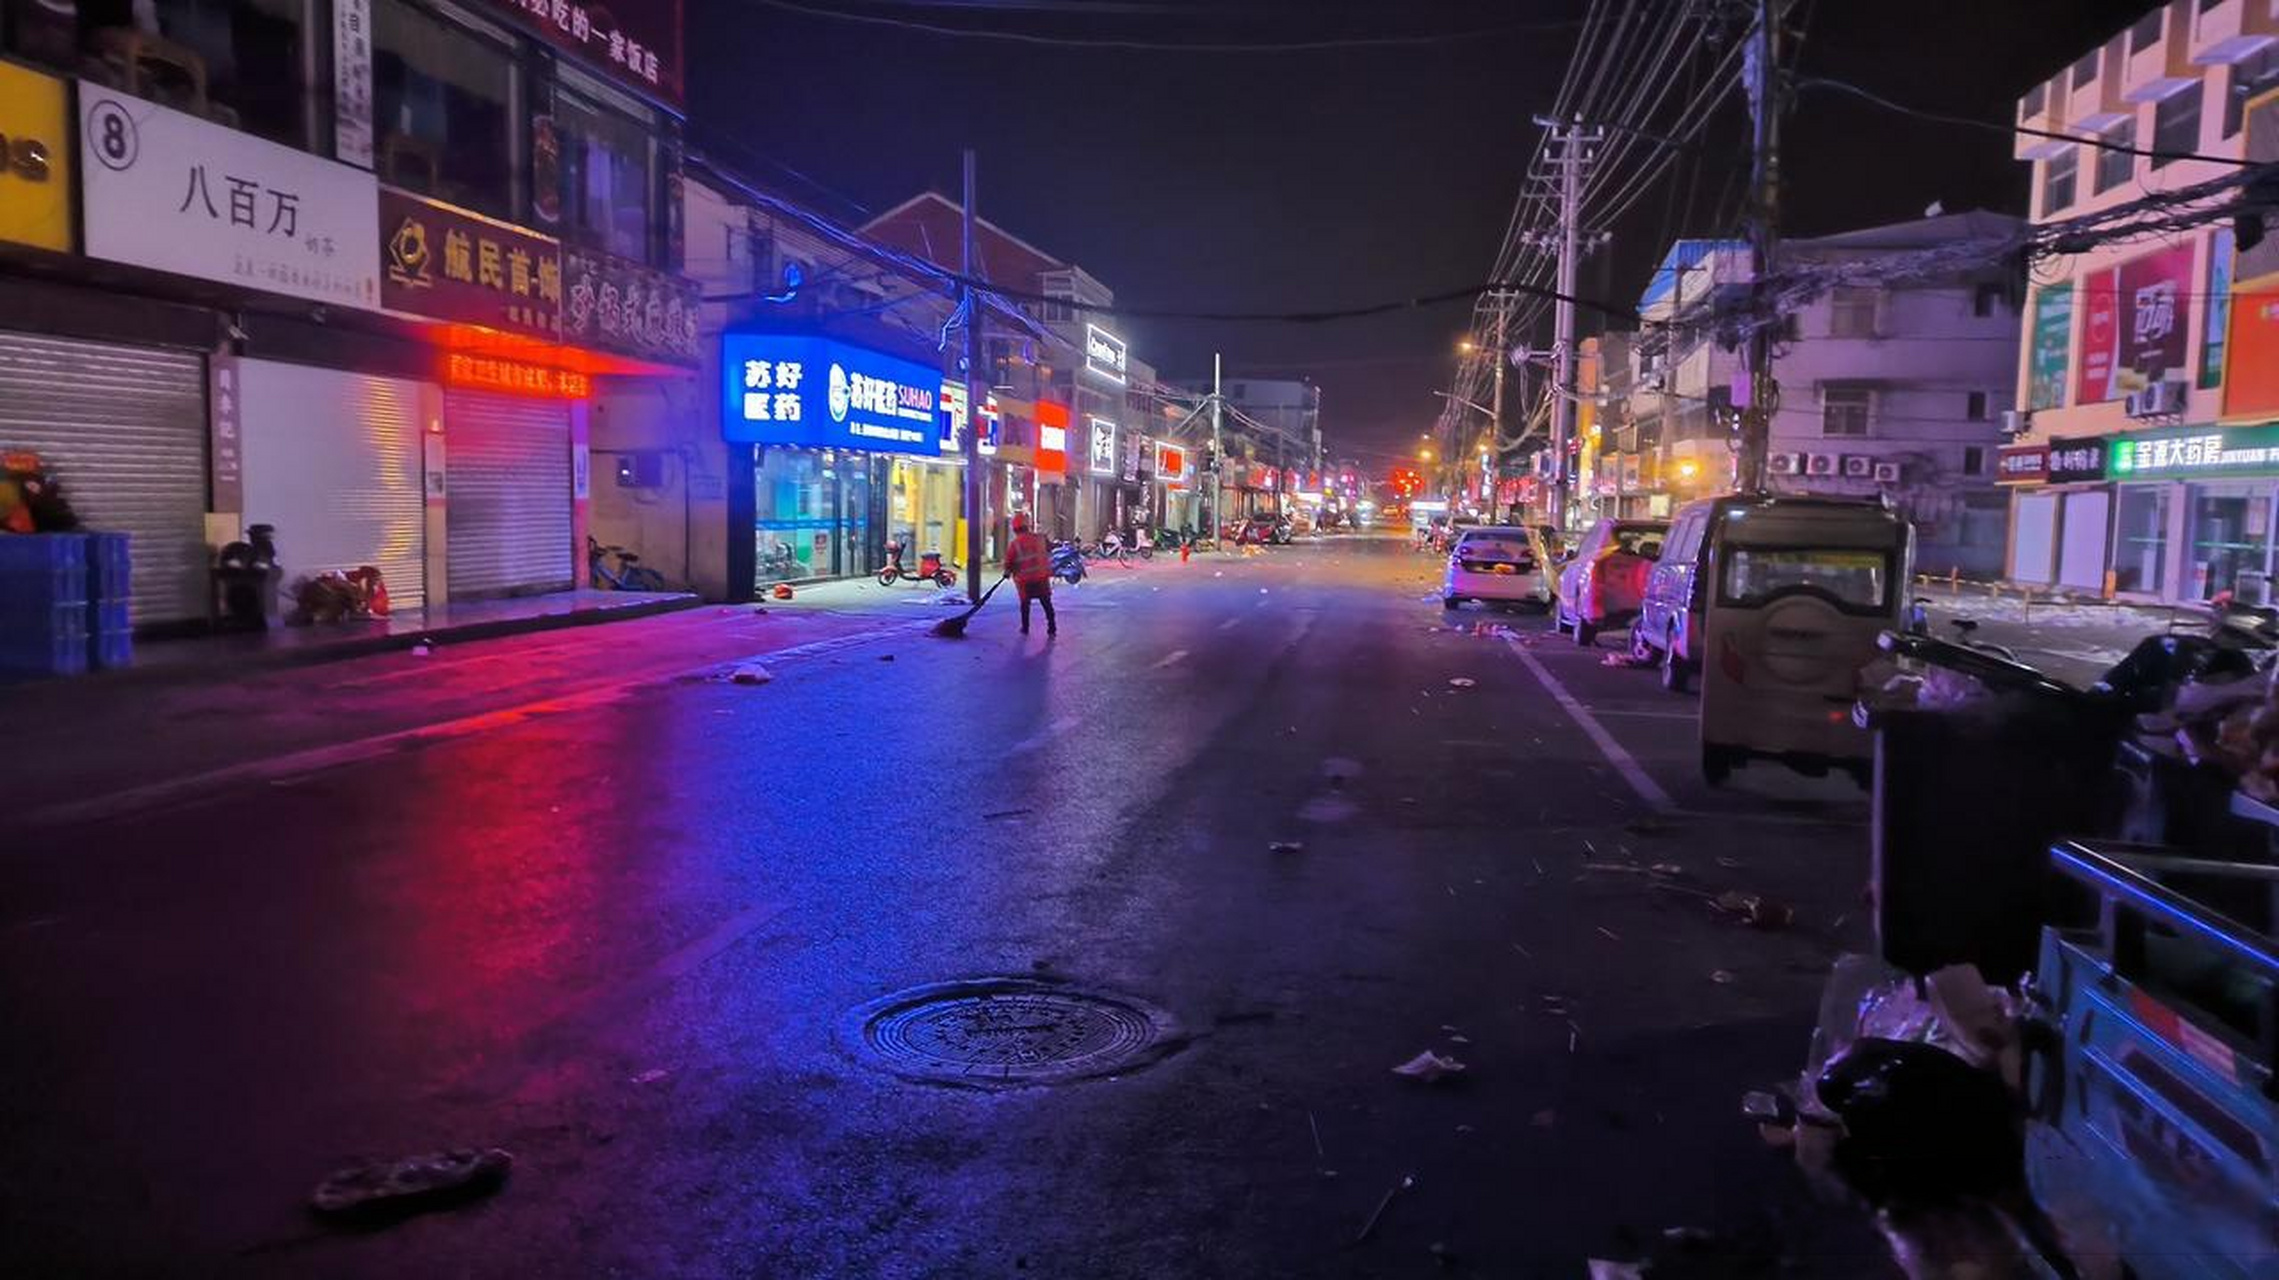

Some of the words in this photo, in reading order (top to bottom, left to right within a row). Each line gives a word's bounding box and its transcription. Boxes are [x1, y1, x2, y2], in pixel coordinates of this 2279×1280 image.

[103, 112, 126, 160] 8
[180, 165, 300, 238] 八百万
[744, 360, 803, 389] 苏好
[744, 393, 801, 421] 医药
[898, 384, 932, 411] SUHAO
[2134, 435, 2222, 469] 金源大药房
